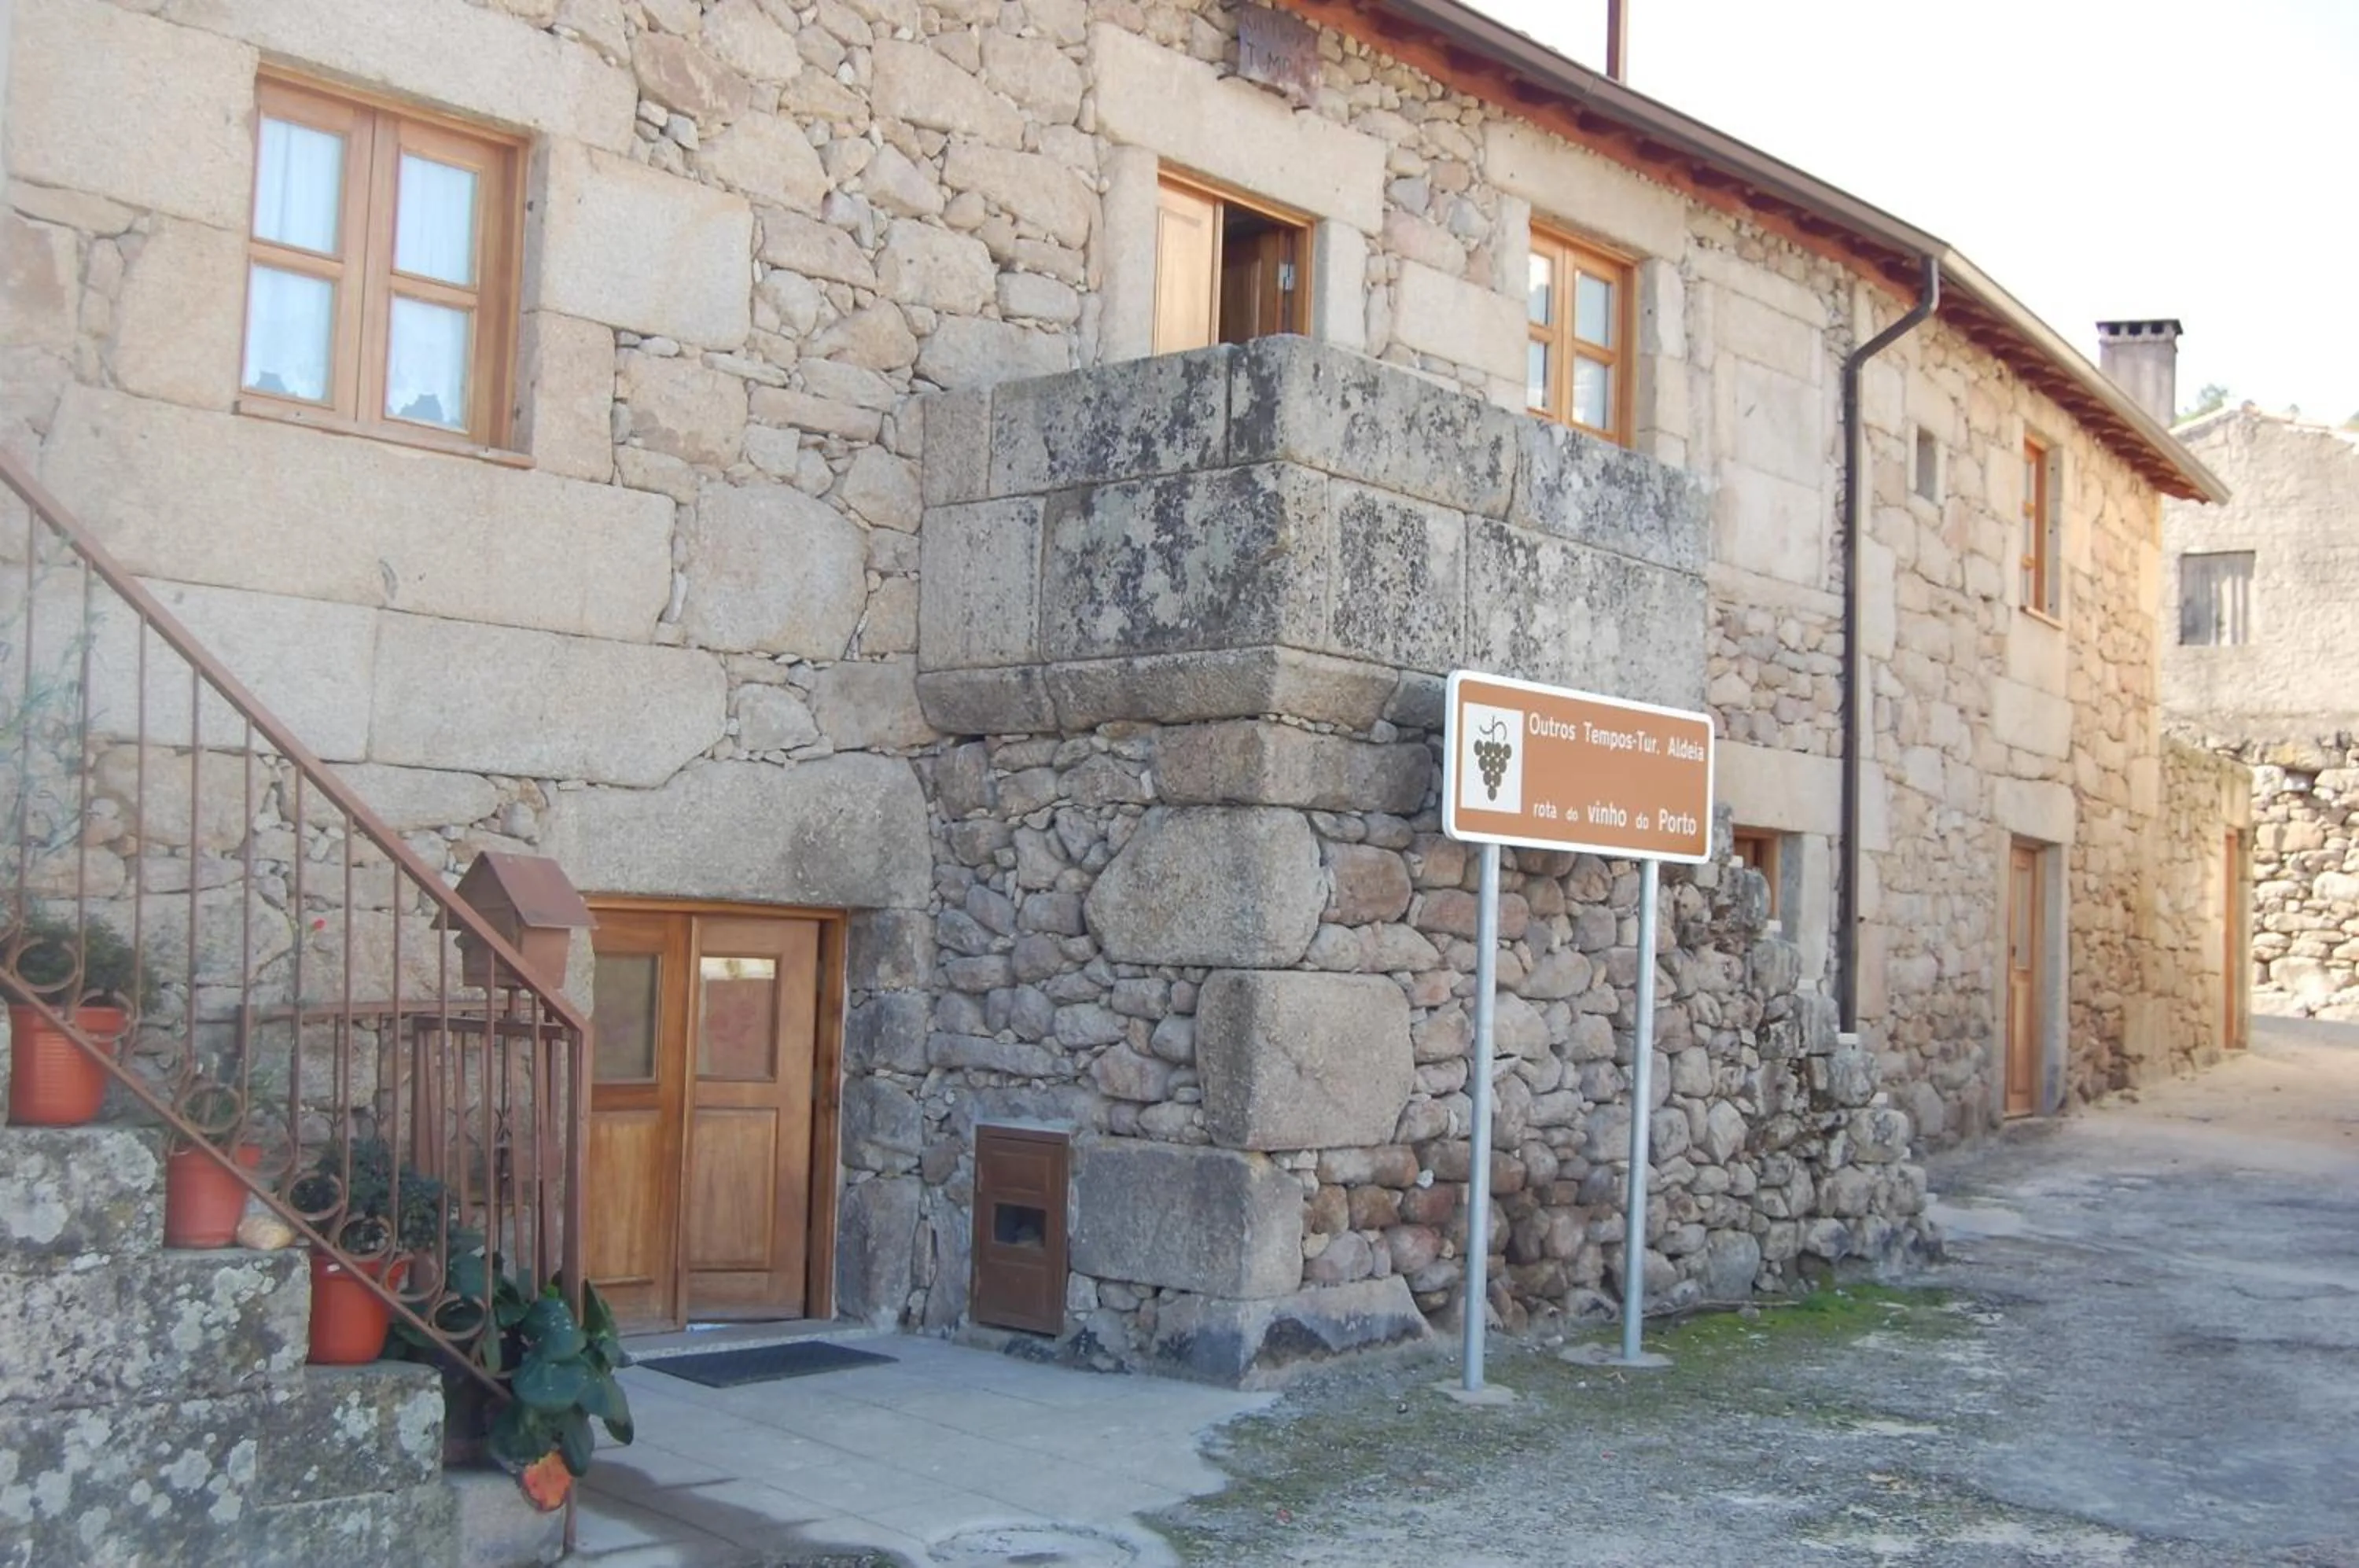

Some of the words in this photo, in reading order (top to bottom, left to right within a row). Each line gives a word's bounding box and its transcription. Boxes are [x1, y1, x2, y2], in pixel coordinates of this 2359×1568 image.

[1529, 712, 1577, 741] Outros
[1583, 721, 1660, 755] Tempos-Tur.
[1668, 736, 1704, 762] Aldeia
[1533, 801, 1557, 819] rota
[1566, 806, 1579, 821] do
[1588, 800, 1627, 827] vinho
[1636, 812, 1649, 830] do
[1658, 808, 1696, 835] Porto
